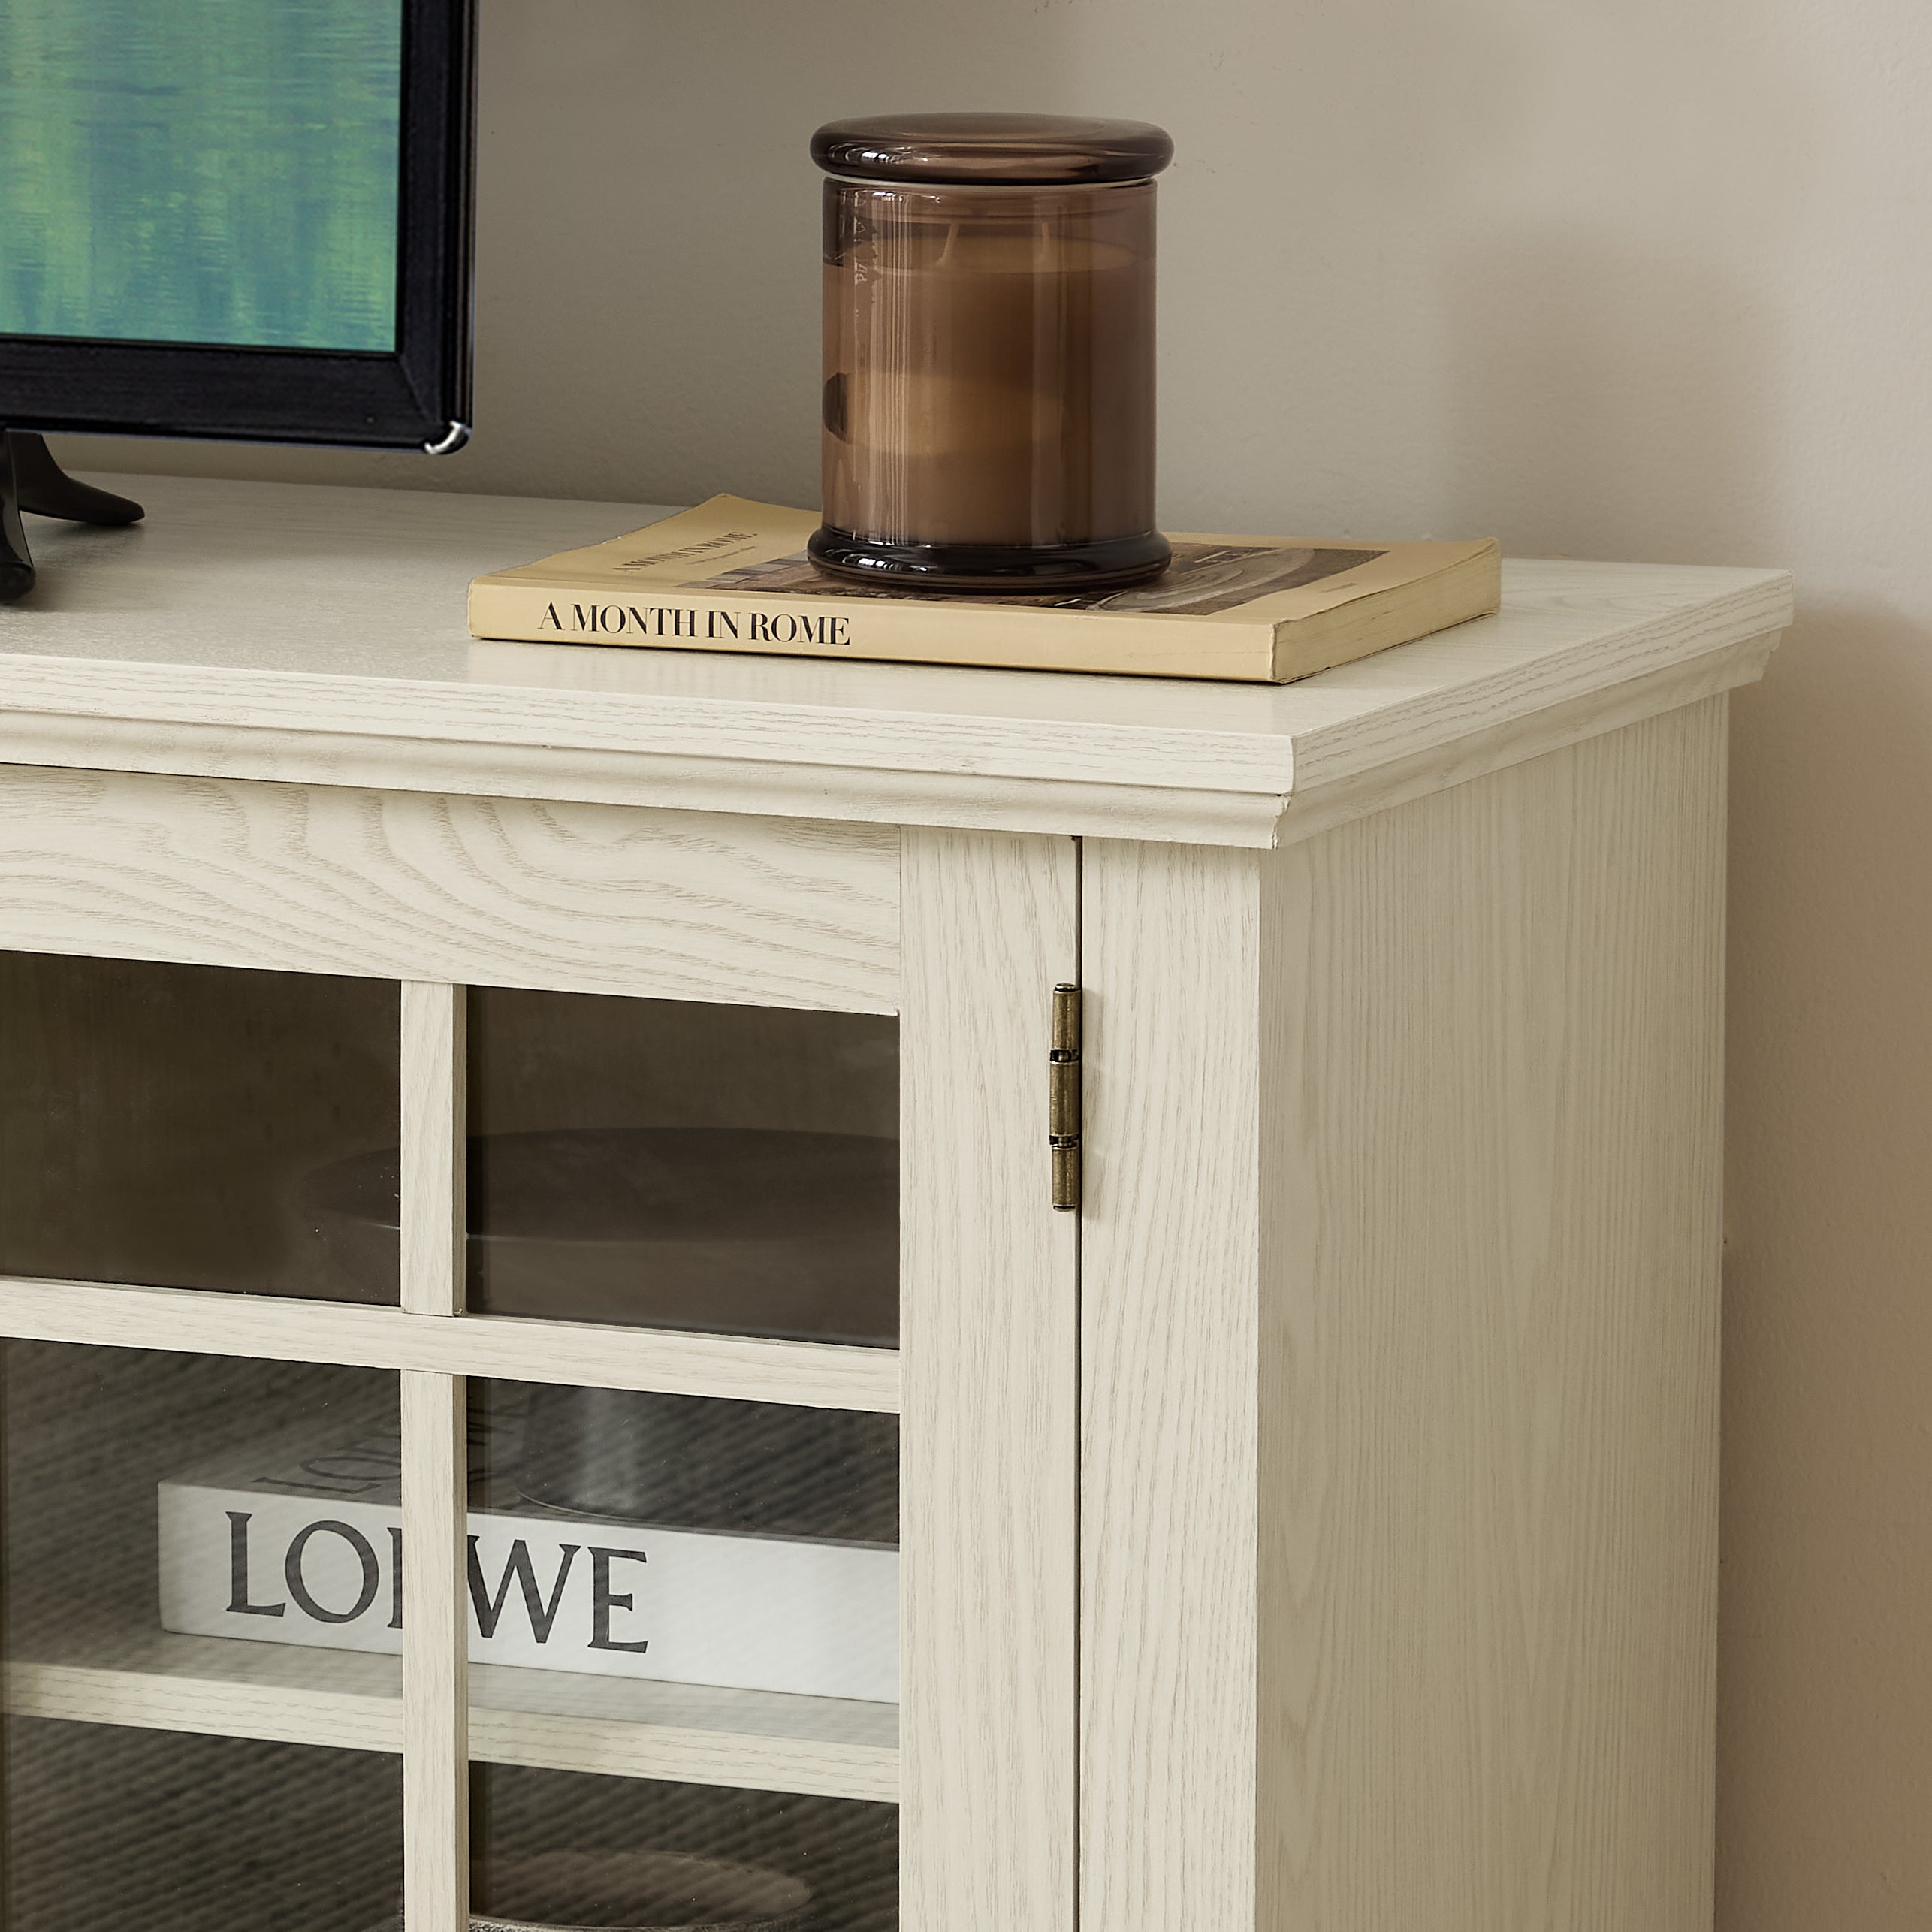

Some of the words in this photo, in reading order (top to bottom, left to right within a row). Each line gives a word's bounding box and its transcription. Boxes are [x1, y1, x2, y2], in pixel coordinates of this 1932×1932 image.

[538, 601, 564, 631] A
[571, 604, 697, 637] MONTH
[706, 609, 740, 639] IN
[749, 612, 850, 645] ROME
[225, 1511, 648, 1653] LOWE
